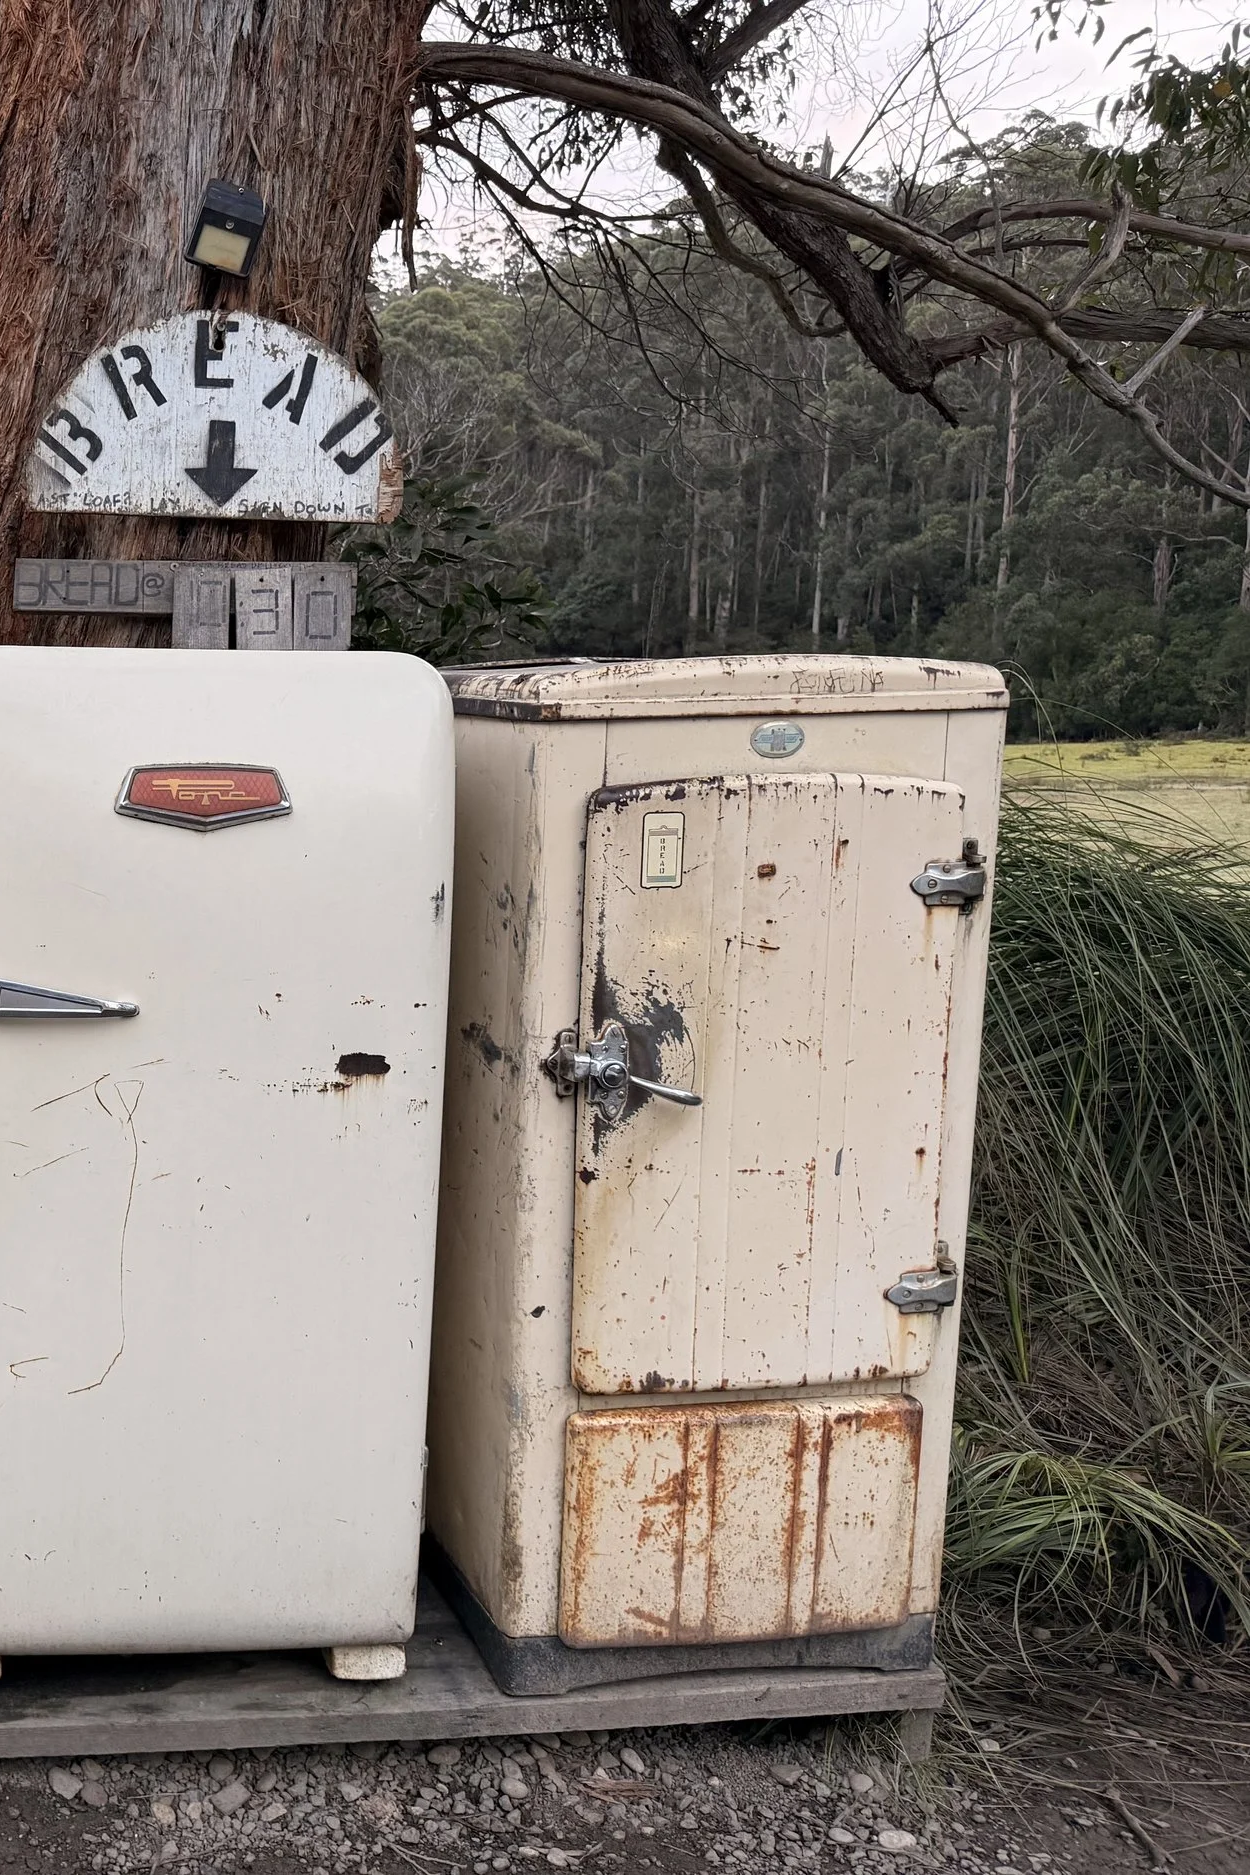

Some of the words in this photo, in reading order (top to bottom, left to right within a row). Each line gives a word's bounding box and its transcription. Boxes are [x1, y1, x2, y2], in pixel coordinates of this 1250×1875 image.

[39, 319, 394, 477] BREAD
[294, 500, 345, 514] DOWN
[14, 564, 139, 607] BREAD
[142, 572, 165, 598] @
